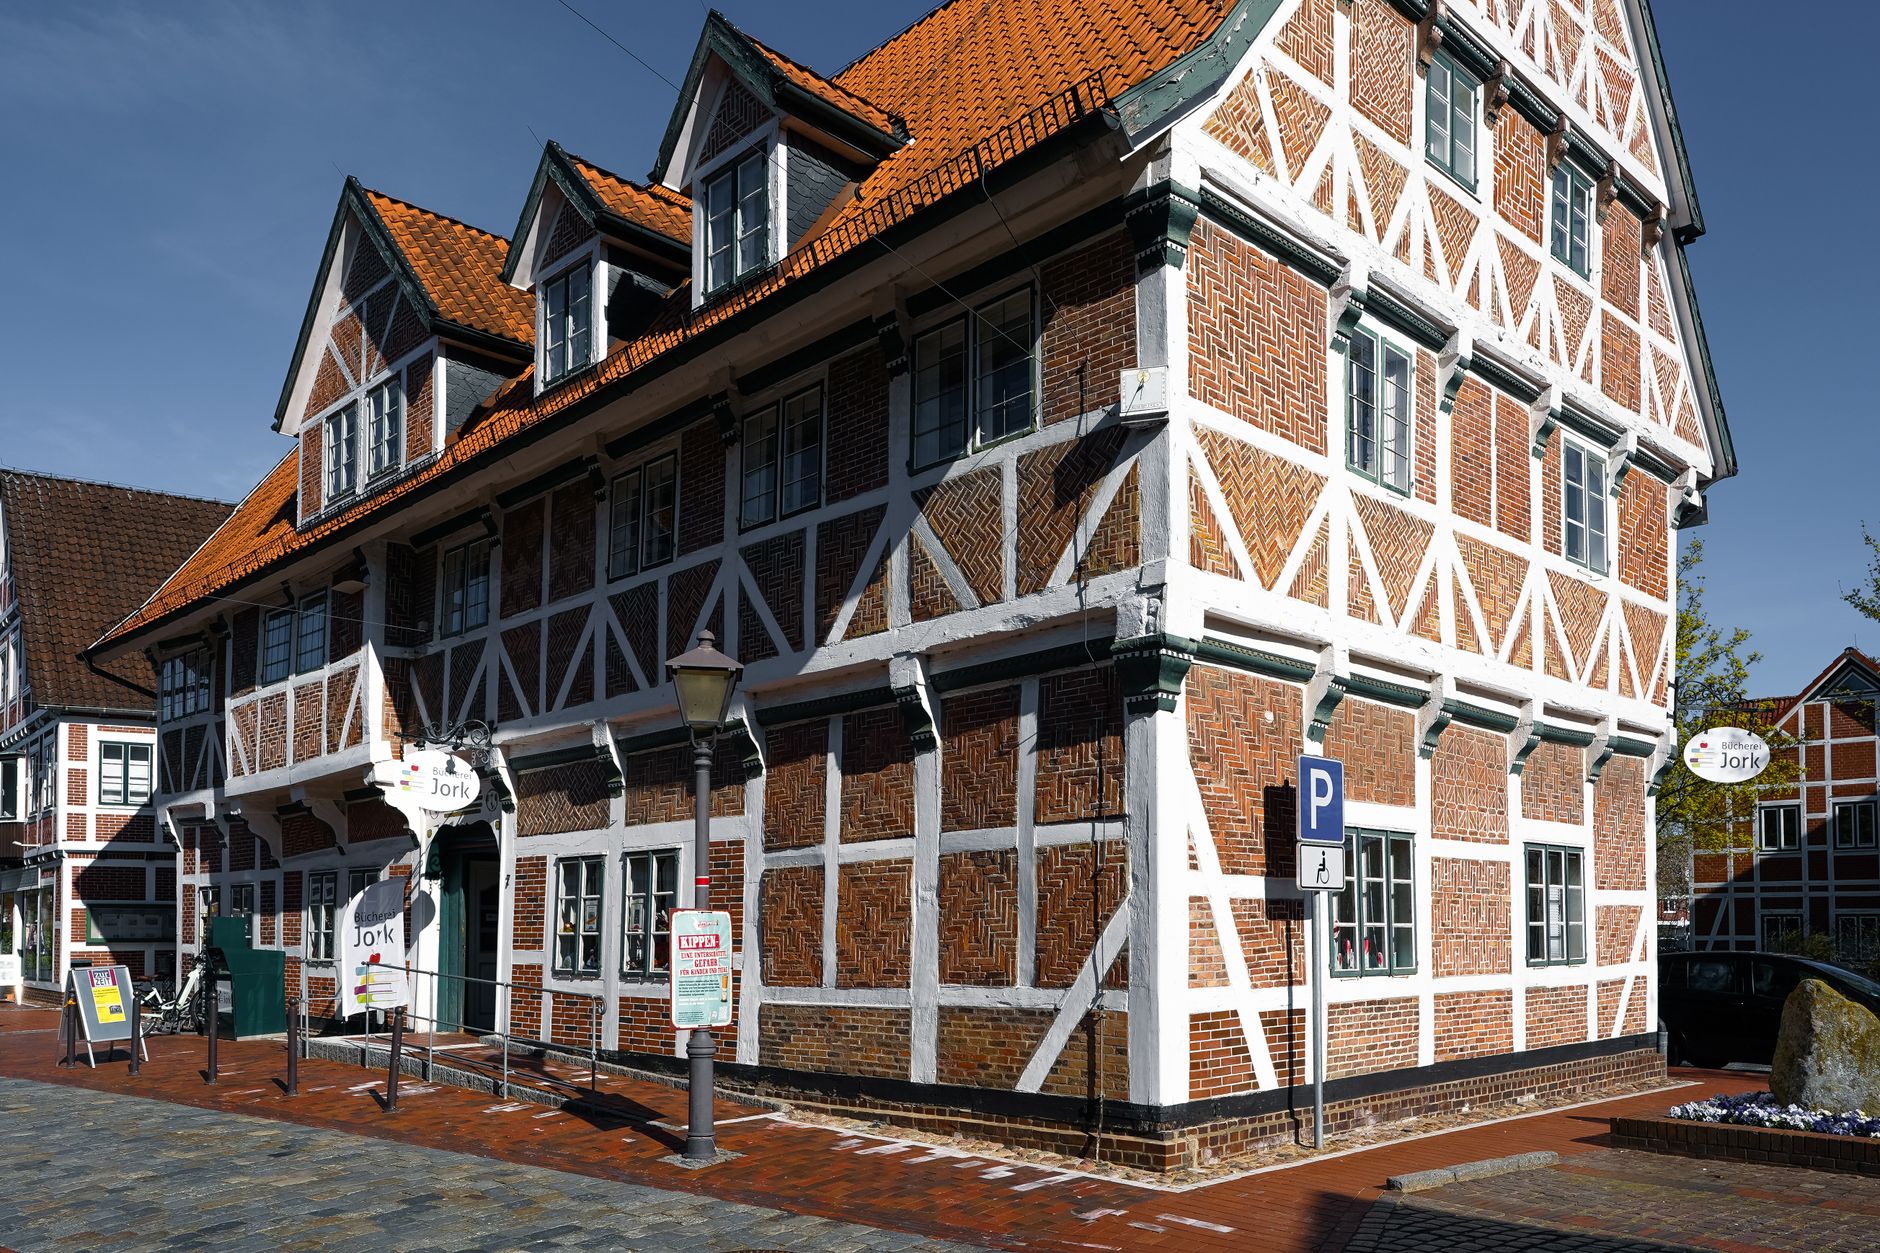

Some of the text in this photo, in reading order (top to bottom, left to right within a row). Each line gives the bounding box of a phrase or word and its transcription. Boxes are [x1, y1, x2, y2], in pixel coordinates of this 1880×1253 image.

[1721, 741, 1762, 750] Bücherei
[1720, 752, 1760, 769] Jork
[431, 778, 470, 799] Jork
[1310, 768, 1334, 830] P
[354, 909, 396, 923] Bücherei
[353, 923, 394, 947] Jork
[680, 935, 719, 949] KIPPEN-
[694, 959, 718, 967] GEFAHR
[95, 978, 111, 986] ZEIT
